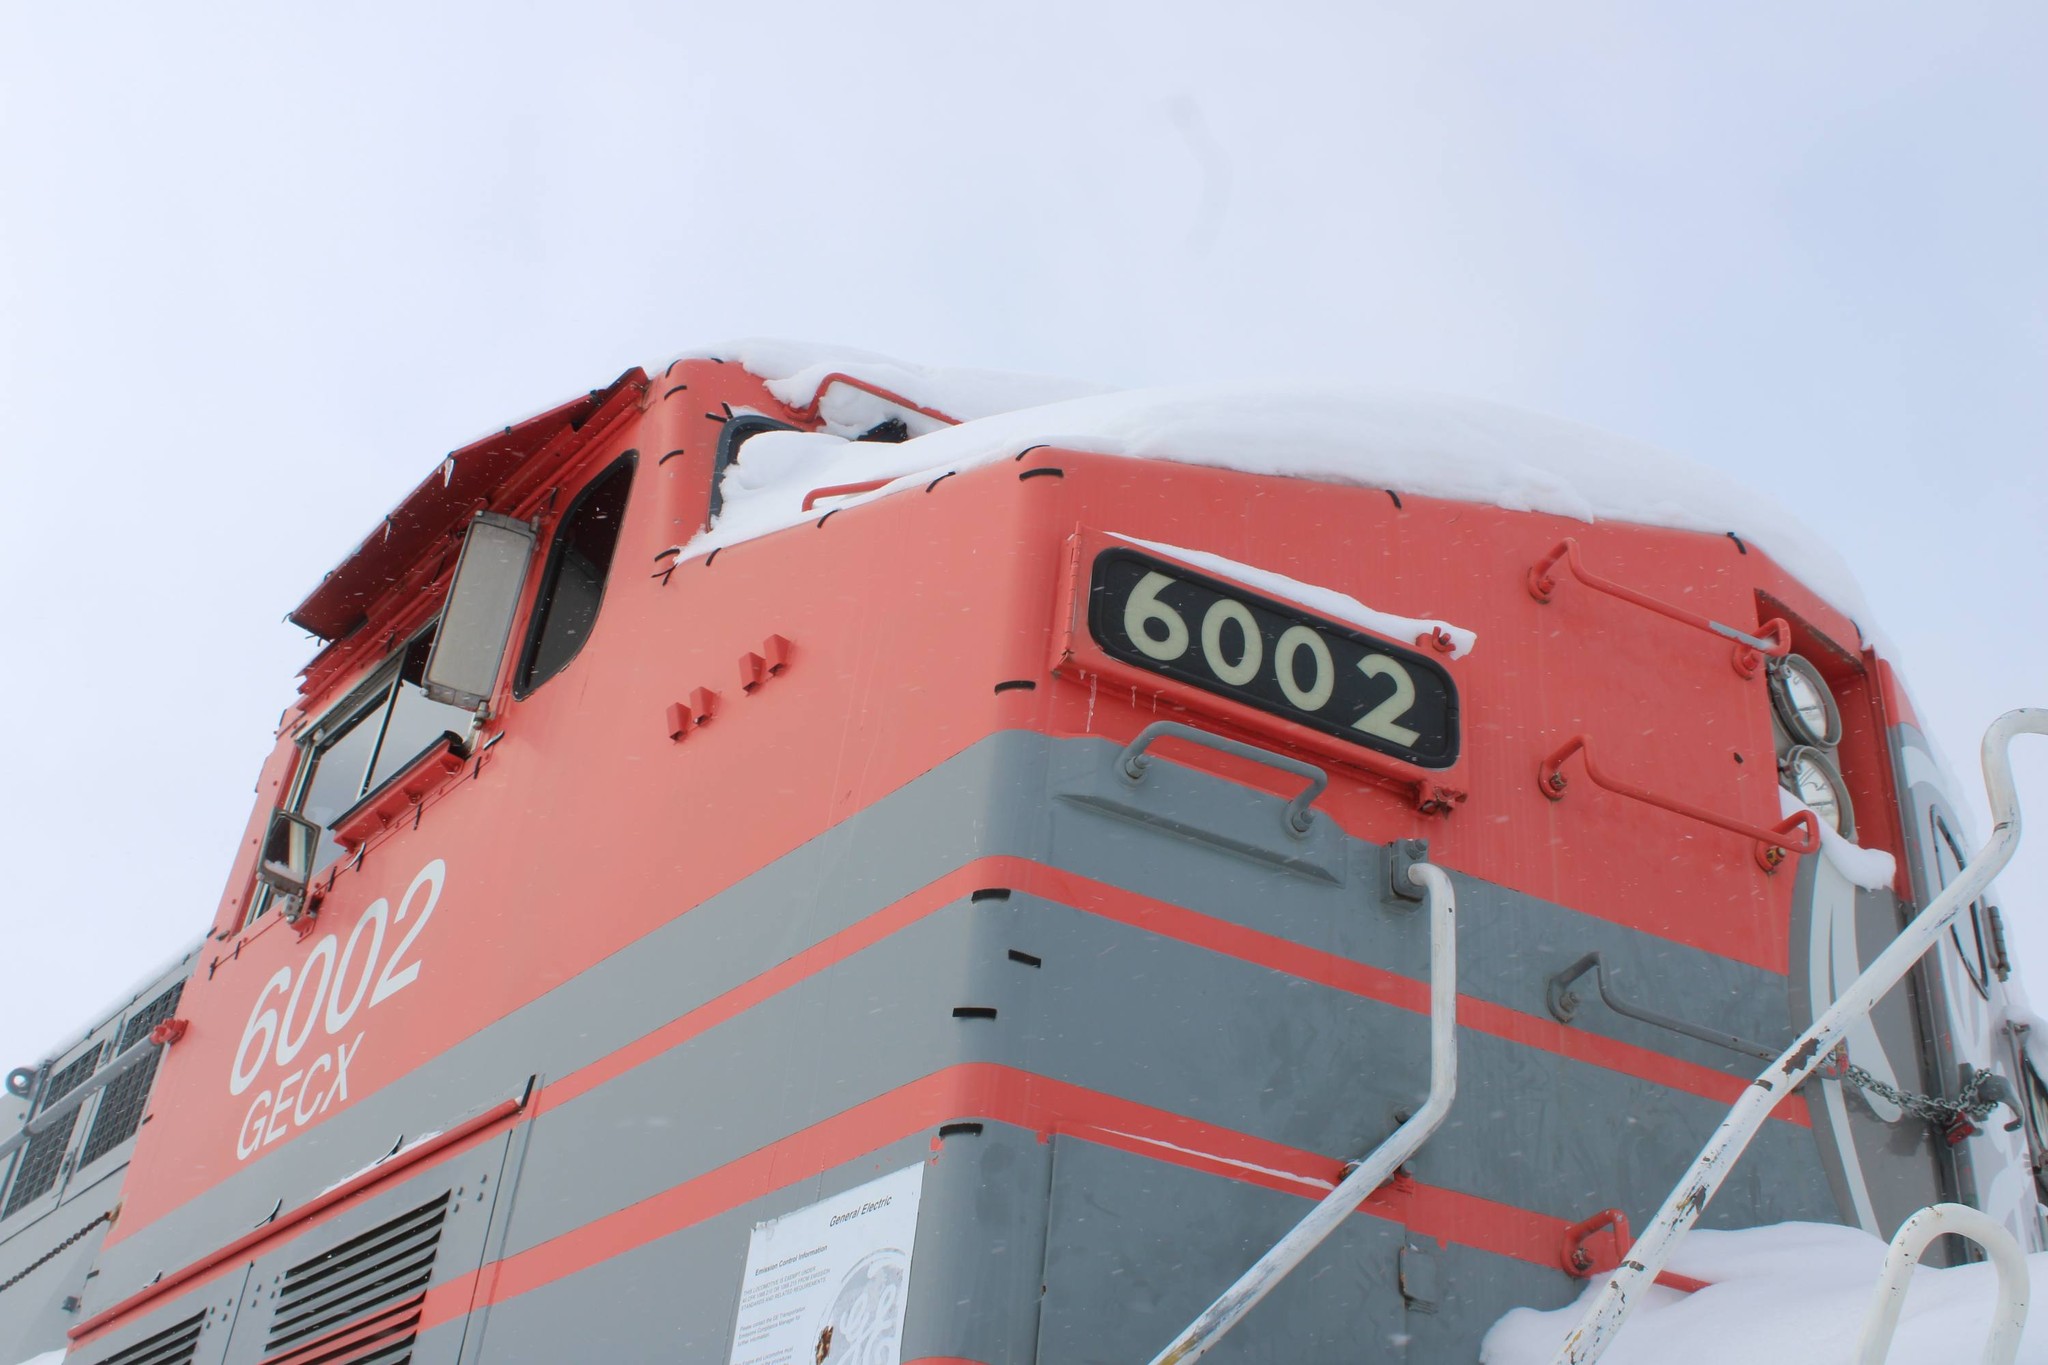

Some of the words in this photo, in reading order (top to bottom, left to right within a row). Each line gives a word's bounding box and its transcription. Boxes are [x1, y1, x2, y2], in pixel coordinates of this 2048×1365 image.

[1123, 571, 1420, 748] 6002
[230, 858, 446, 1096] 6002
[237, 1031, 365, 1160] GECX
[755, 1263, 778, 1276] Emission
[779, 1253, 798, 1267] Control
[798, 1244, 828, 1260] Information
[830, 1206, 861, 1227] General
[861, 1195, 892, 1215] Electric
